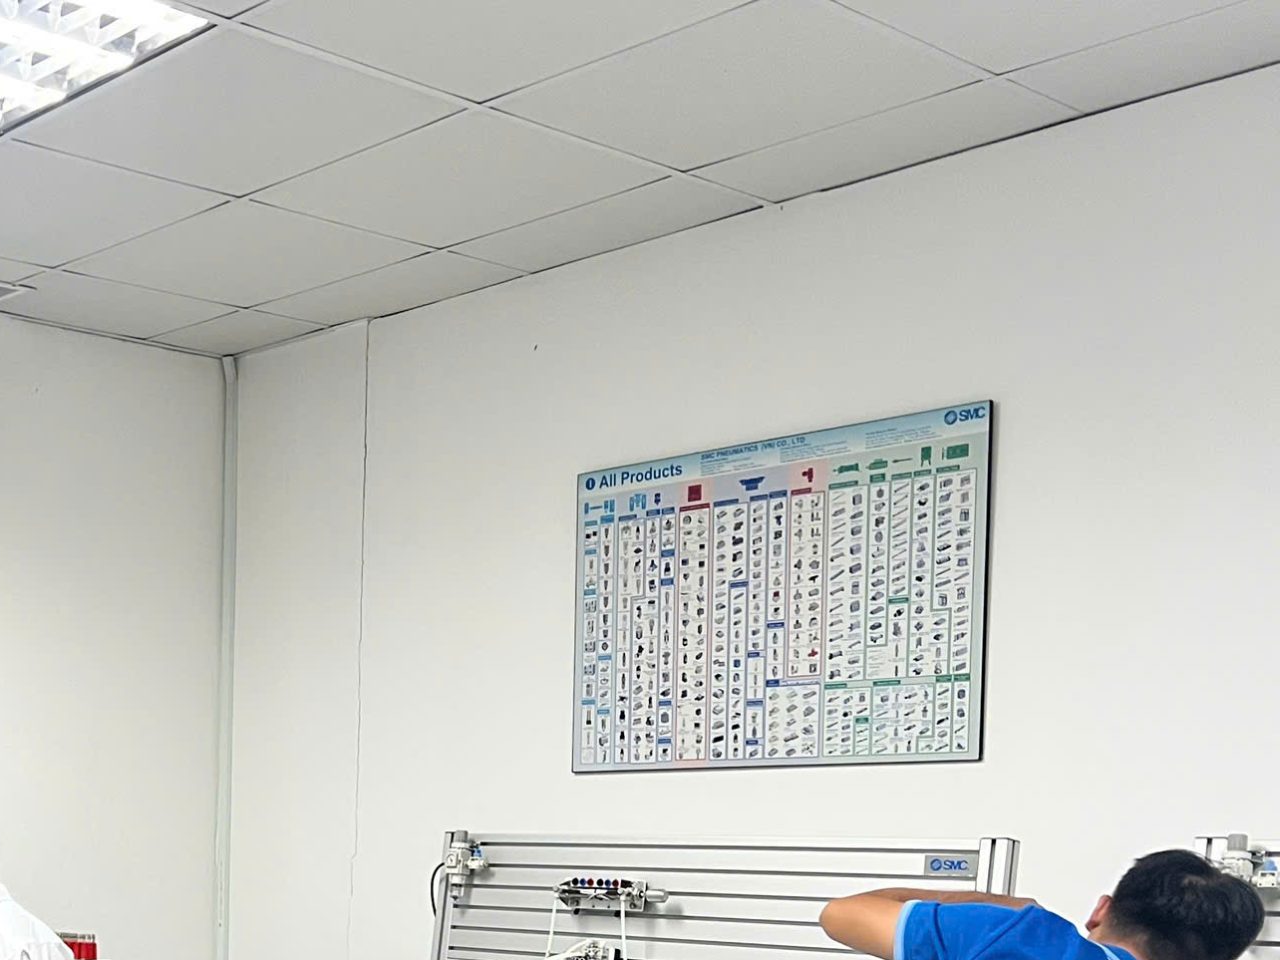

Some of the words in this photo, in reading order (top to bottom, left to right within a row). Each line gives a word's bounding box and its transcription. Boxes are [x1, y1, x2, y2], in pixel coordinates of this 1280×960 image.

[959, 406, 986, 422] SMC
[599, 473, 617, 489] All
[621, 464, 683, 485] Products
[943, 859, 969, 871] SMC
